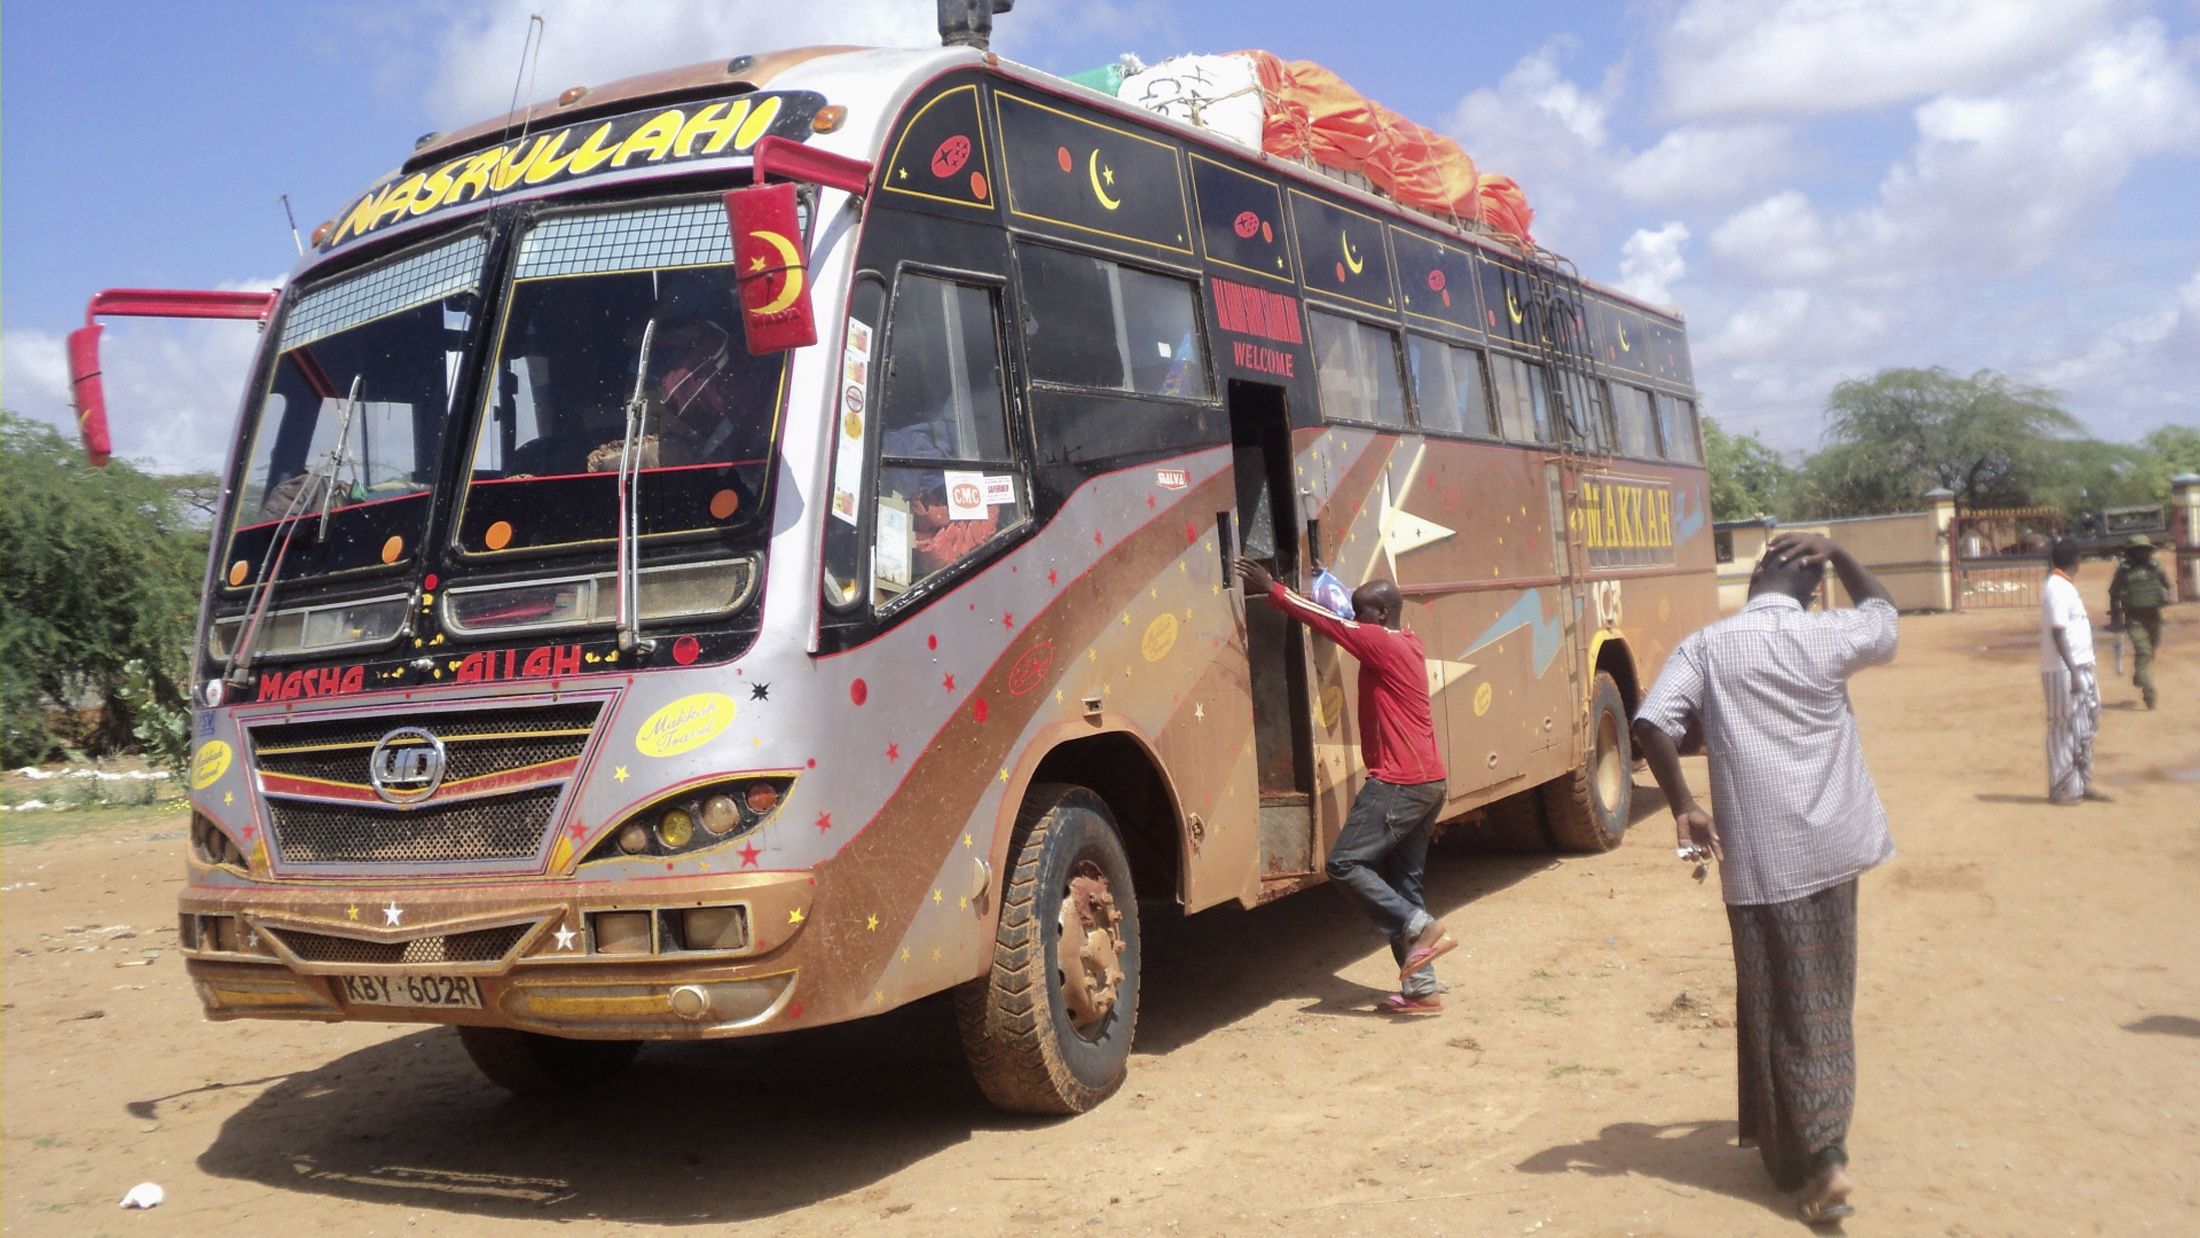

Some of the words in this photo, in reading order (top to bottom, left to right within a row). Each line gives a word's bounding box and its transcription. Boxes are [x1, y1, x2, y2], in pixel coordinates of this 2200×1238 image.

[333, 95, 782, 246] NASRULLAHI
[1232, 341, 1294, 378] WELCOME
[1583, 482, 1673, 547] MAKKAH
[256, 666, 363, 702] MASHA
[343, 975, 390, 1001] KBY
[407, 975, 477, 1006] 602R
